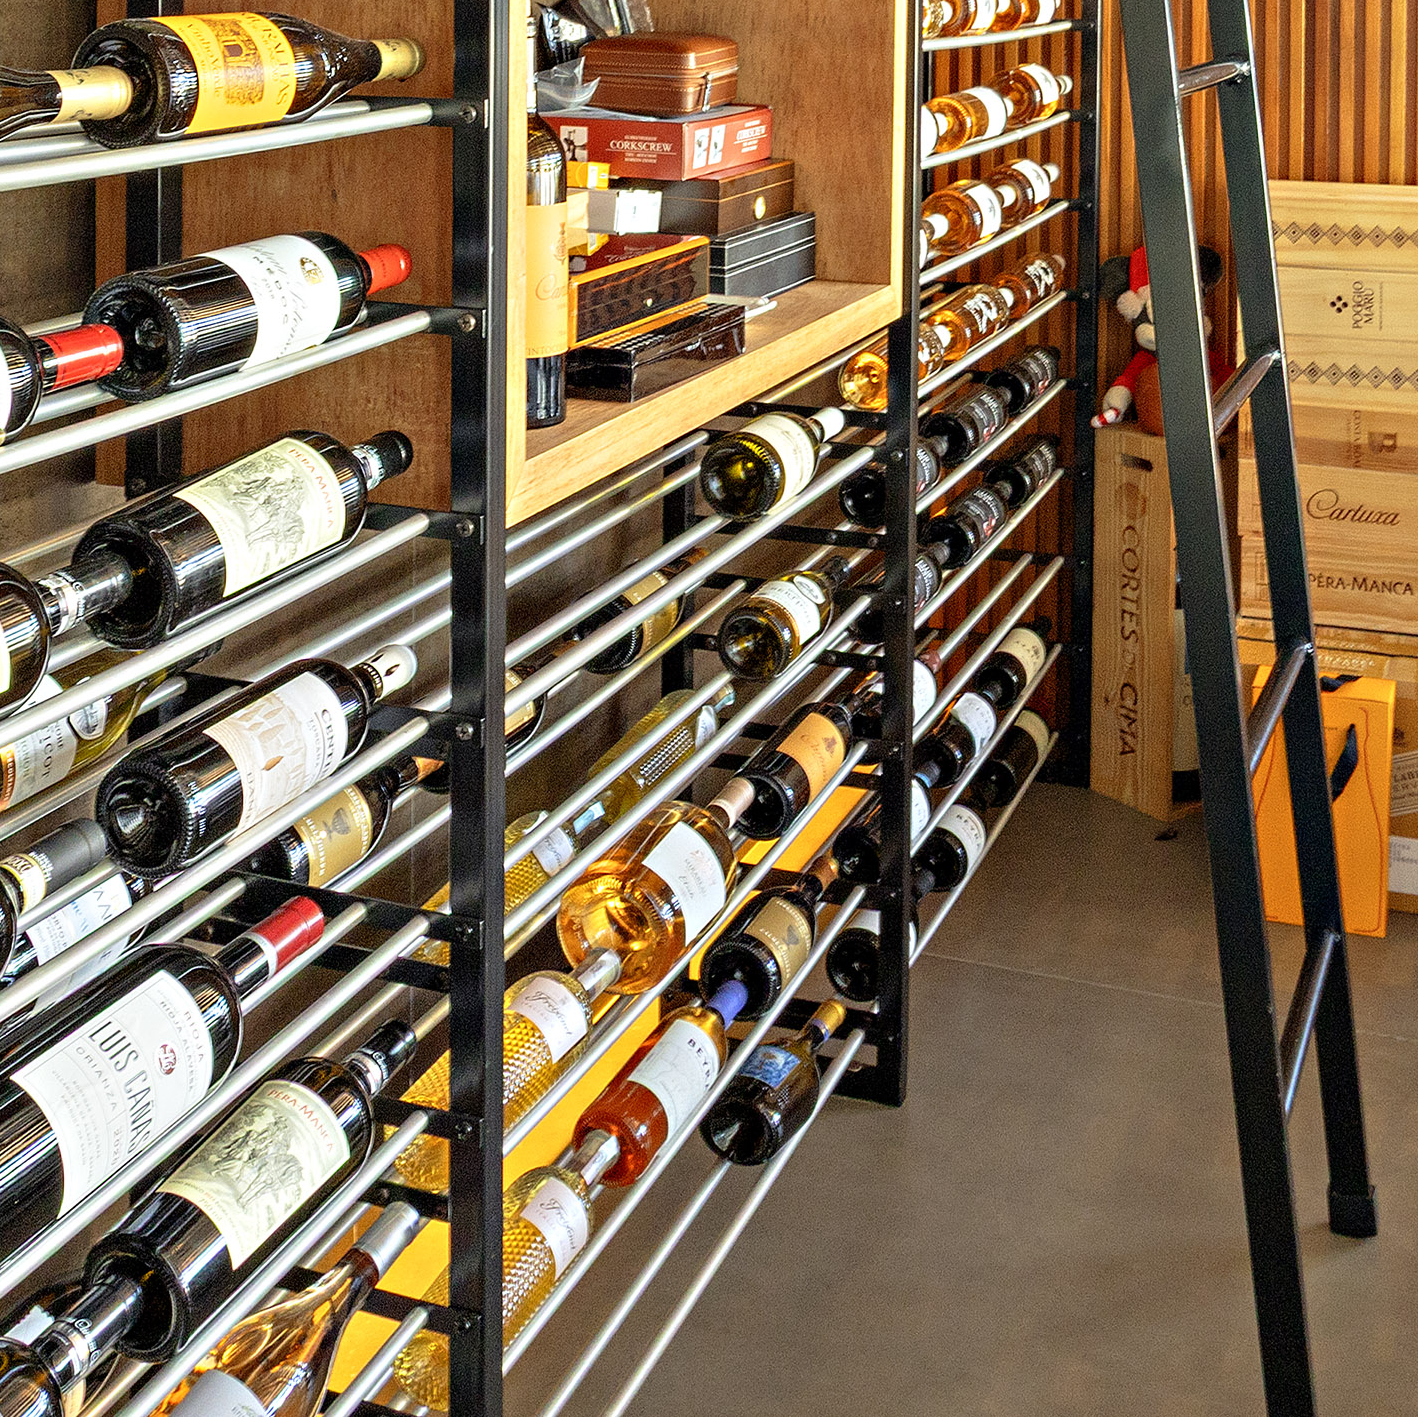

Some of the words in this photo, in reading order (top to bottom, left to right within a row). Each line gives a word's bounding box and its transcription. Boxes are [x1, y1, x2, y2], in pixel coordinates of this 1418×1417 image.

[609, 138, 674, 154] CORKSCREW
[1352, 281, 1364, 330] POGGIO
[1306, 488, 1401, 527] Cartuxa
[1120, 524, 1141, 644] CORTES
[1308, 572, 1415, 597] PÊRA-MANCA
[320, 708, 336, 779] CENTI
[1119, 682, 1139, 756] CIMA
[160, 1000, 183, 1034] RIOJA
[183, 1010, 205, 1063] RIOJA
[75, 1046, 118, 1111] CRIANZA
[88, 1020, 140, 1072] LUIS
[123, 1069, 155, 1155] CAÑAS
[267, 1088, 335, 1153] PÊRA-MANCA
